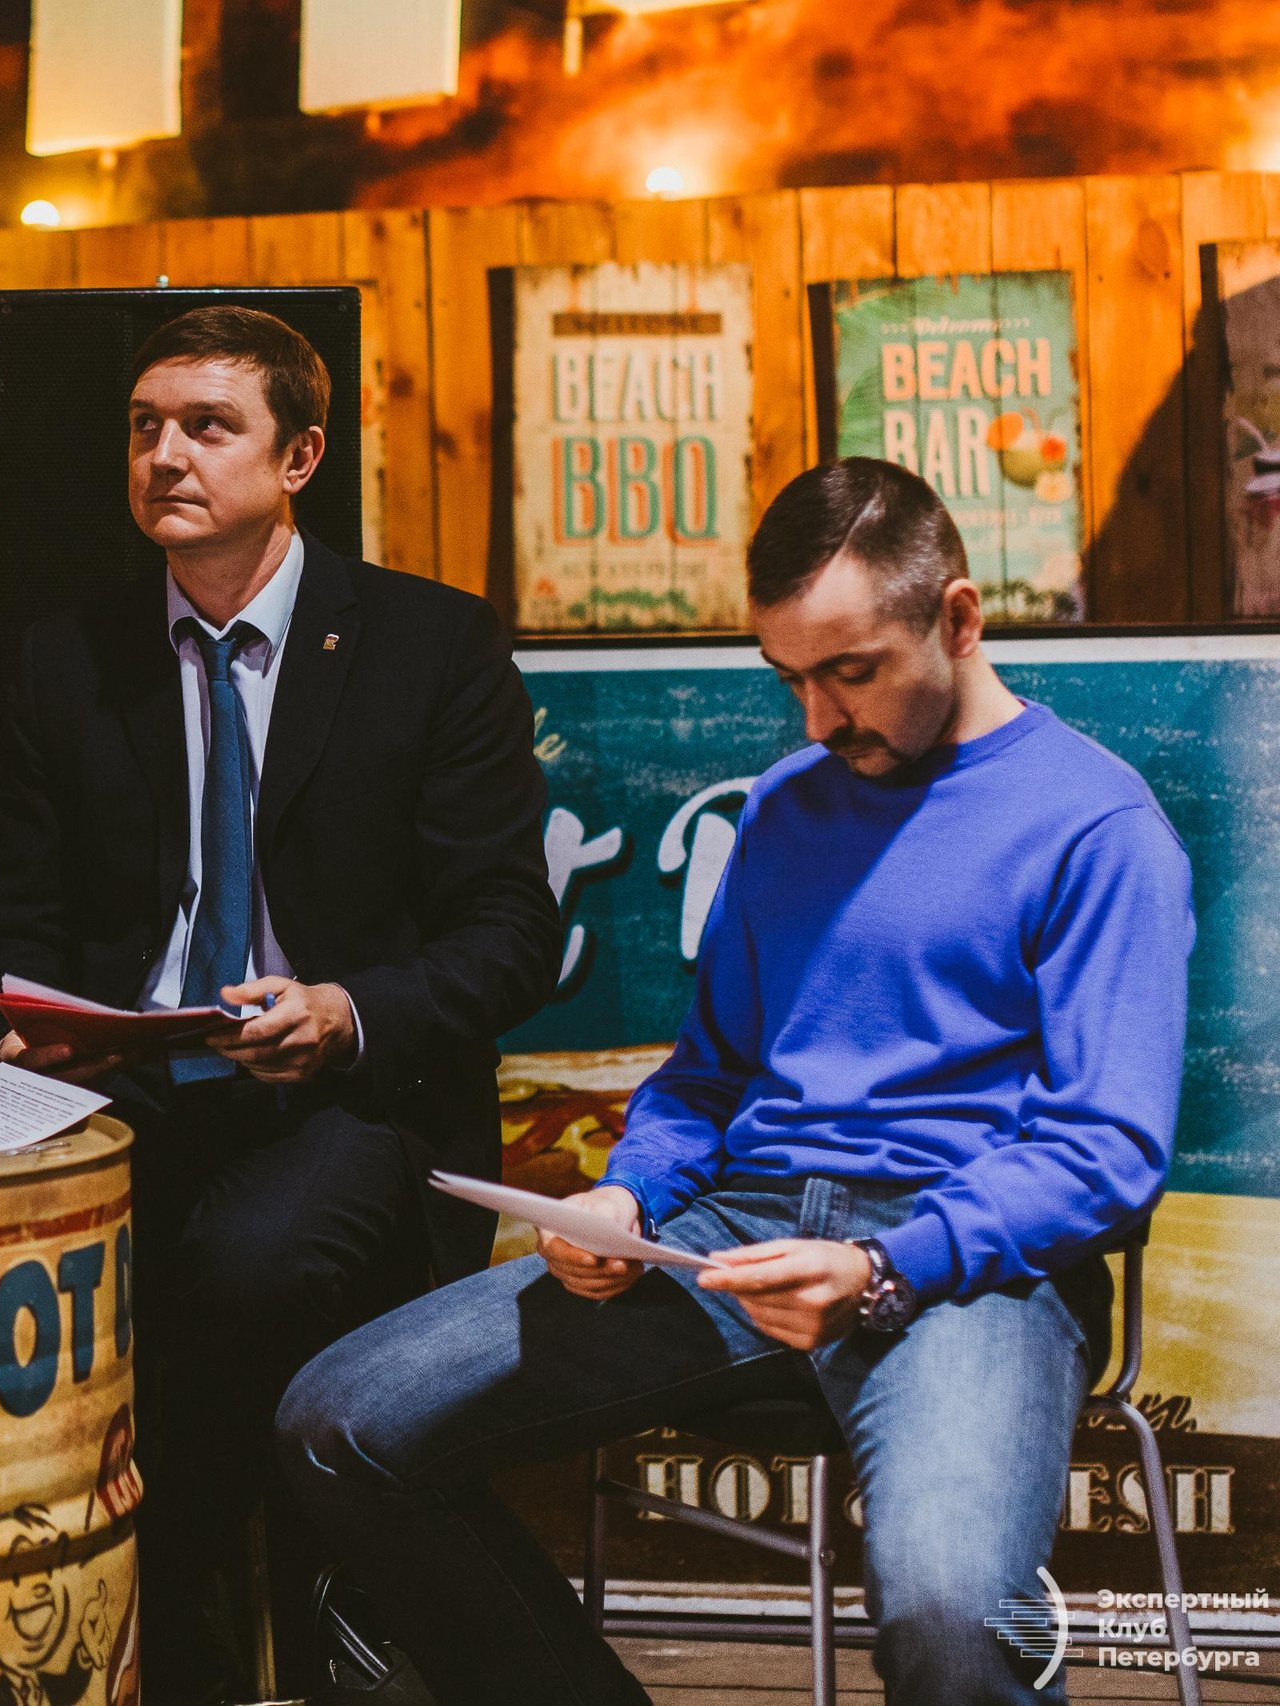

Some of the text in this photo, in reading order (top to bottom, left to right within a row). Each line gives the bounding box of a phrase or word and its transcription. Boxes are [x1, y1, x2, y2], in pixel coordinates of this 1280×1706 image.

[552, 349, 719, 425] BEACH
[881, 336, 1052, 401] BEACH
[883, 406, 990, 498] BAR
[552, 435, 721, 548] BBQ
[635, 1453, 812, 1524] HOT
